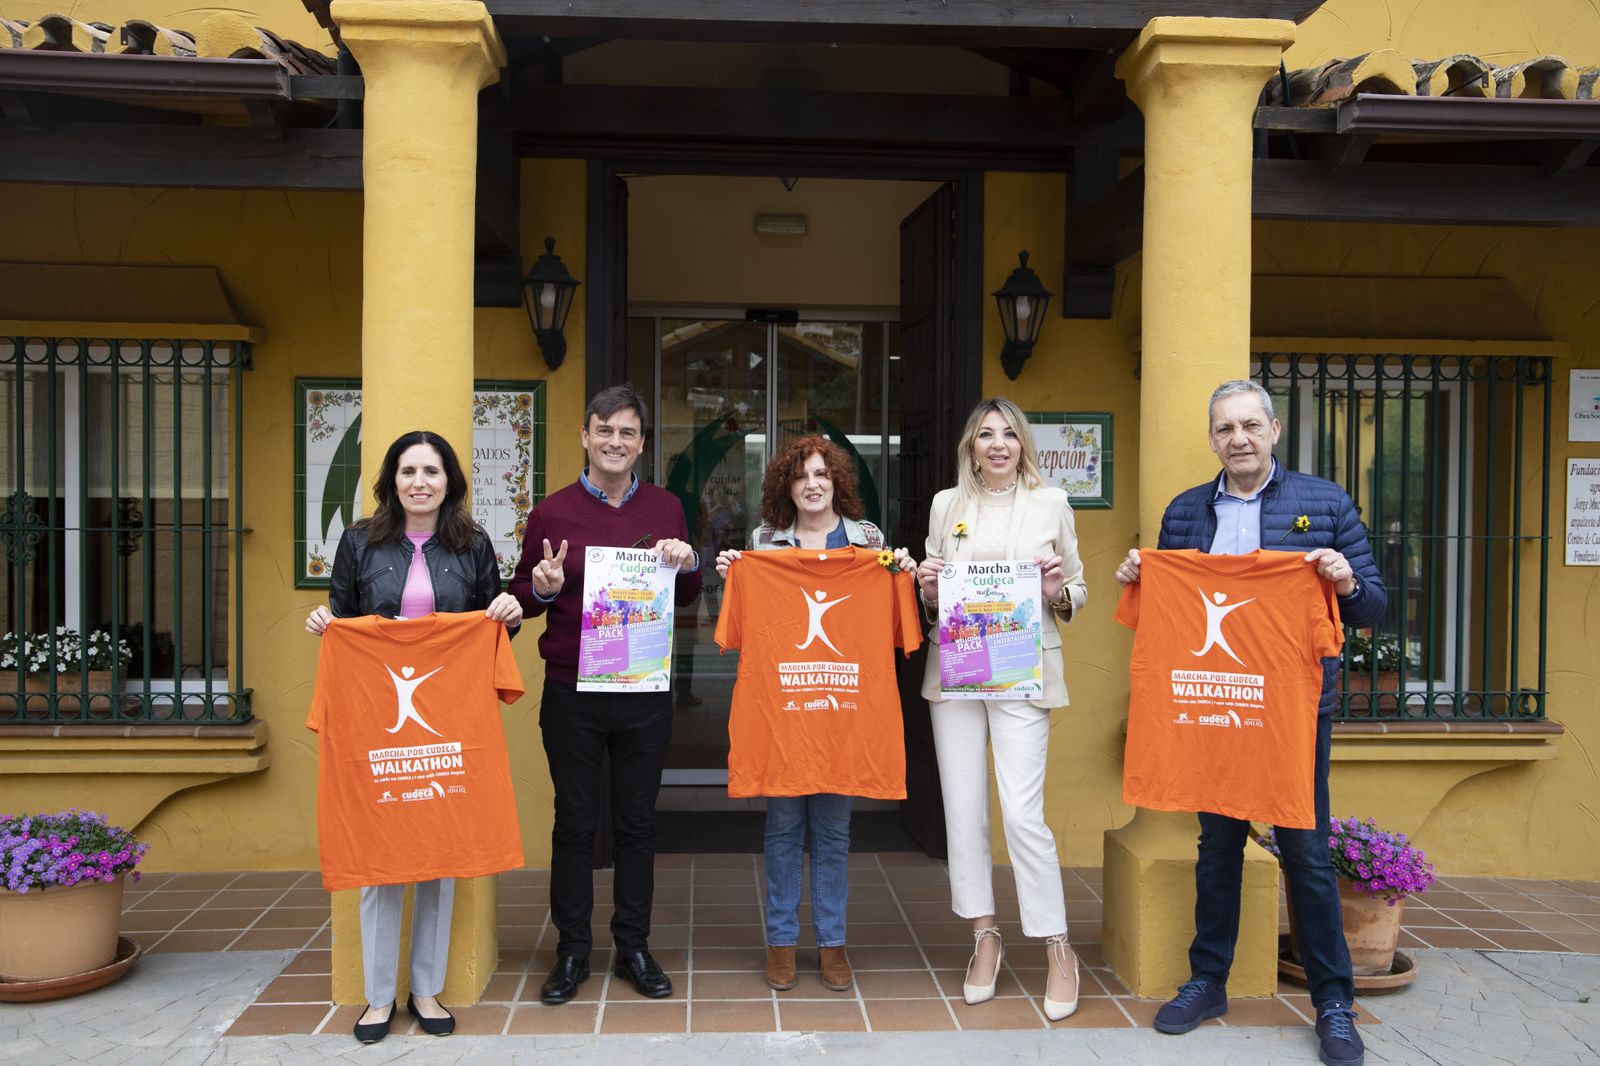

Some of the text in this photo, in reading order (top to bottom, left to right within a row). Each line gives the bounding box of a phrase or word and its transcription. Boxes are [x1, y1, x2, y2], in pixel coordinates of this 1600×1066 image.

[616, 552, 657, 563] Marcha
[620, 563, 657, 574] Cudeca
[968, 563, 1011, 574] Marcha
[972, 575, 1015, 586] Cudeca
[598, 629, 624, 639] PACK
[957, 640, 983, 652] PACK
[828, 664, 854, 672] CUDECA
[780, 673, 859, 686] WALKATHON
[1174, 673, 1259, 685] MARCHA POR CUDECA
[1172, 683, 1264, 702] WALKATHON
[1199, 714, 1230, 725] cudeca
[371, 745, 456, 760] MARCHA POR CUDECA
[370, 755, 463, 777] WALKATHON
[402, 788, 434, 799] cudeca
